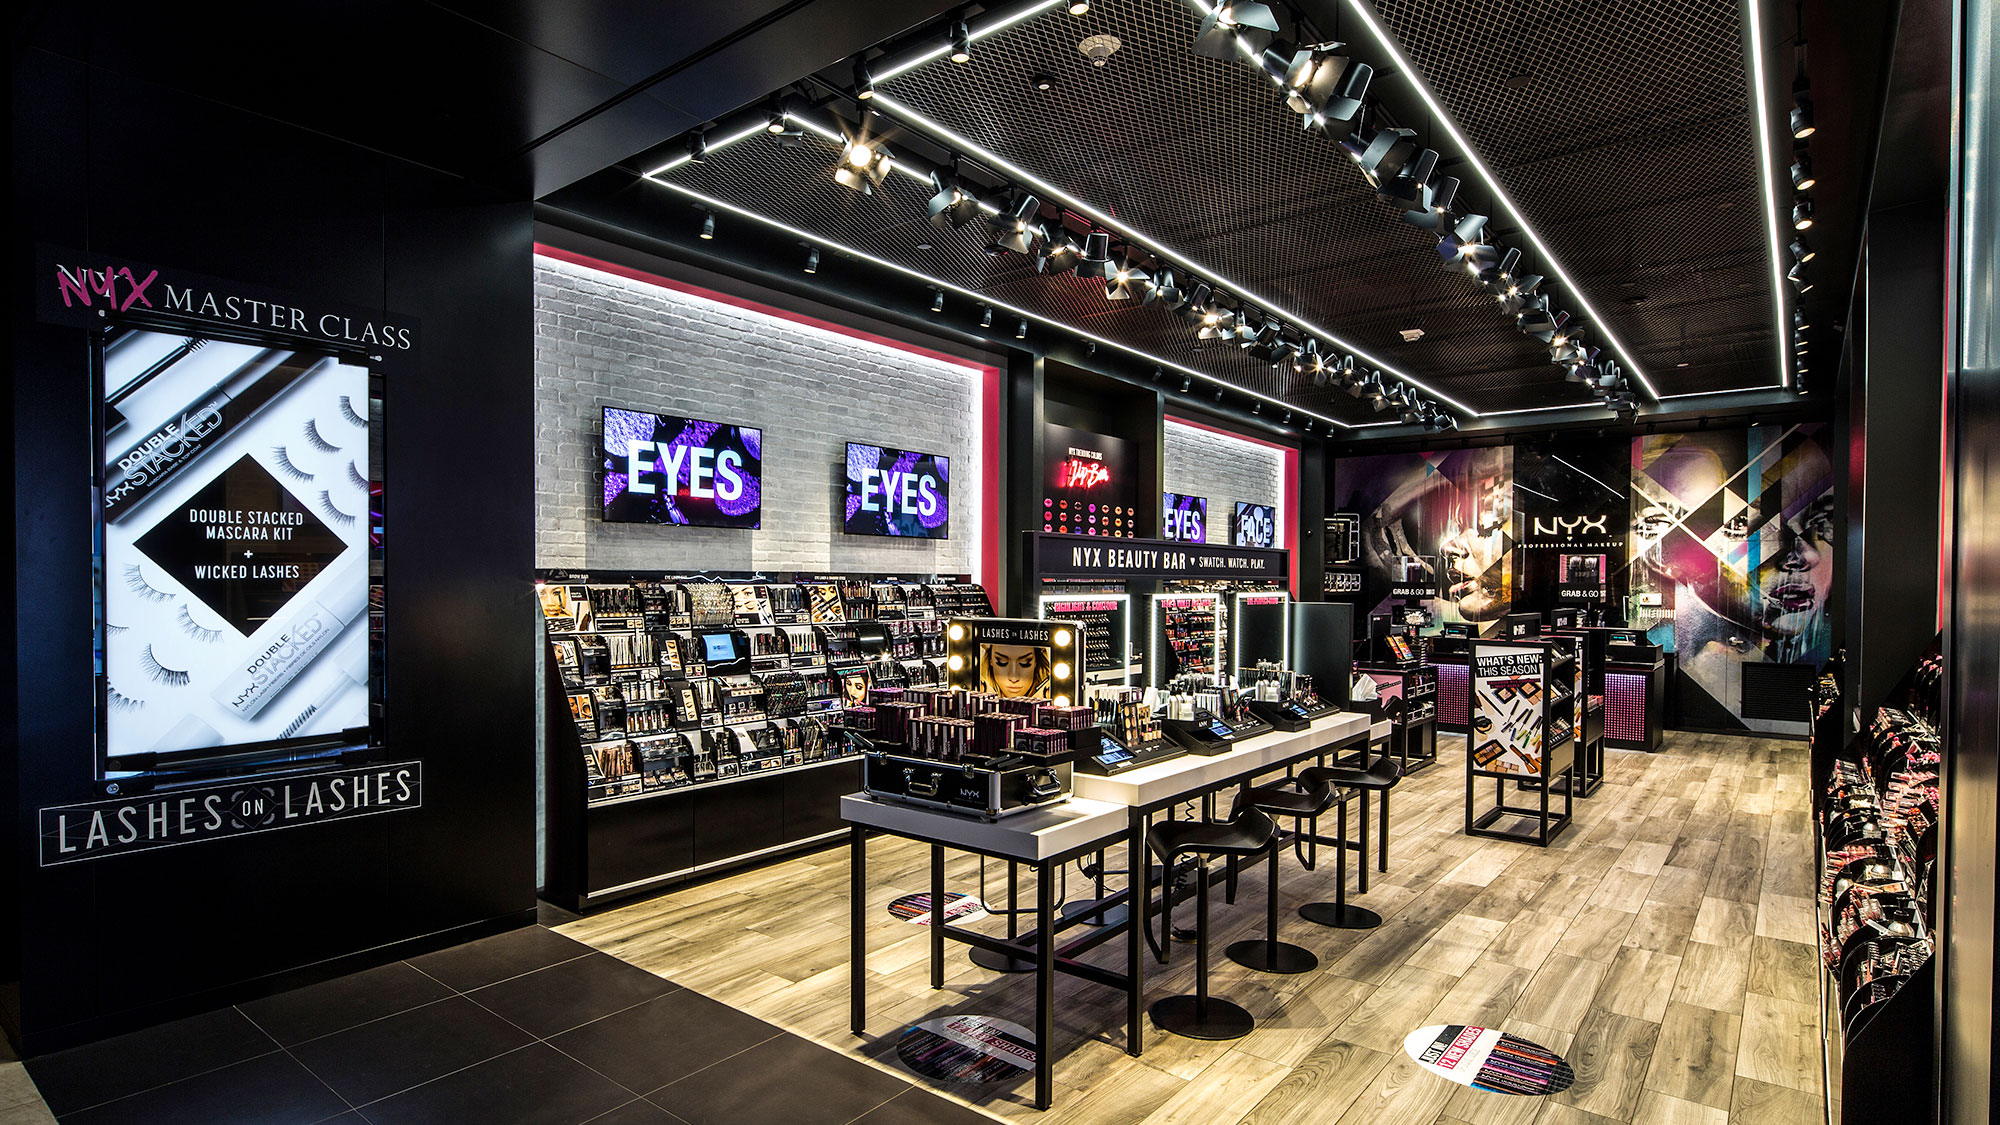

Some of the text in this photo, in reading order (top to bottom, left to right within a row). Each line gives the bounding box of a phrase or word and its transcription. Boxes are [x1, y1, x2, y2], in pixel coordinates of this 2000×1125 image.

[57, 266, 411, 350] NYX MASTER CLASS
[117, 423, 180, 471] DOUBLE
[628, 440, 743, 500] EYES
[861, 468, 937, 516] EYES
[189, 509, 303, 525] DOUBLE STACKED
[1164, 508, 1201, 541] EYES
[1534, 515, 1607, 536] NYX
[206, 526, 293, 540] MASCARA KIT
[1241, 514, 1271, 544] FACE
[1072, 547, 1101, 568] NYX
[1108, 548, 1158, 569] BEAUTY
[1163, 552, 1186, 570] BAR
[194, 565, 300, 579] WICKED LASHES
[1561, 590, 1581, 598] GRAB
[1582, 590, 1588, 598] &
[1588, 590, 1599, 598] GO
[982, 628, 1010, 639] LASHES
[1020, 629, 1049, 641] LASHES
[247, 633, 291, 675] DOUBLE
[1477, 654, 1543, 667] WHAT'S NEW:
[1478, 664, 1538, 677] THIS SEASON
[232, 682, 259, 708] NYX
[960, 788, 980, 798] NYX
[59, 769, 412, 853] LASHES ON LASHES
[1455, 1026, 1482, 1049] SHADES
[991, 1038, 1036, 1063] SHADES
[1446, 1045, 1464, 1063] NEW
[1438, 1058, 1456, 1070] 12
